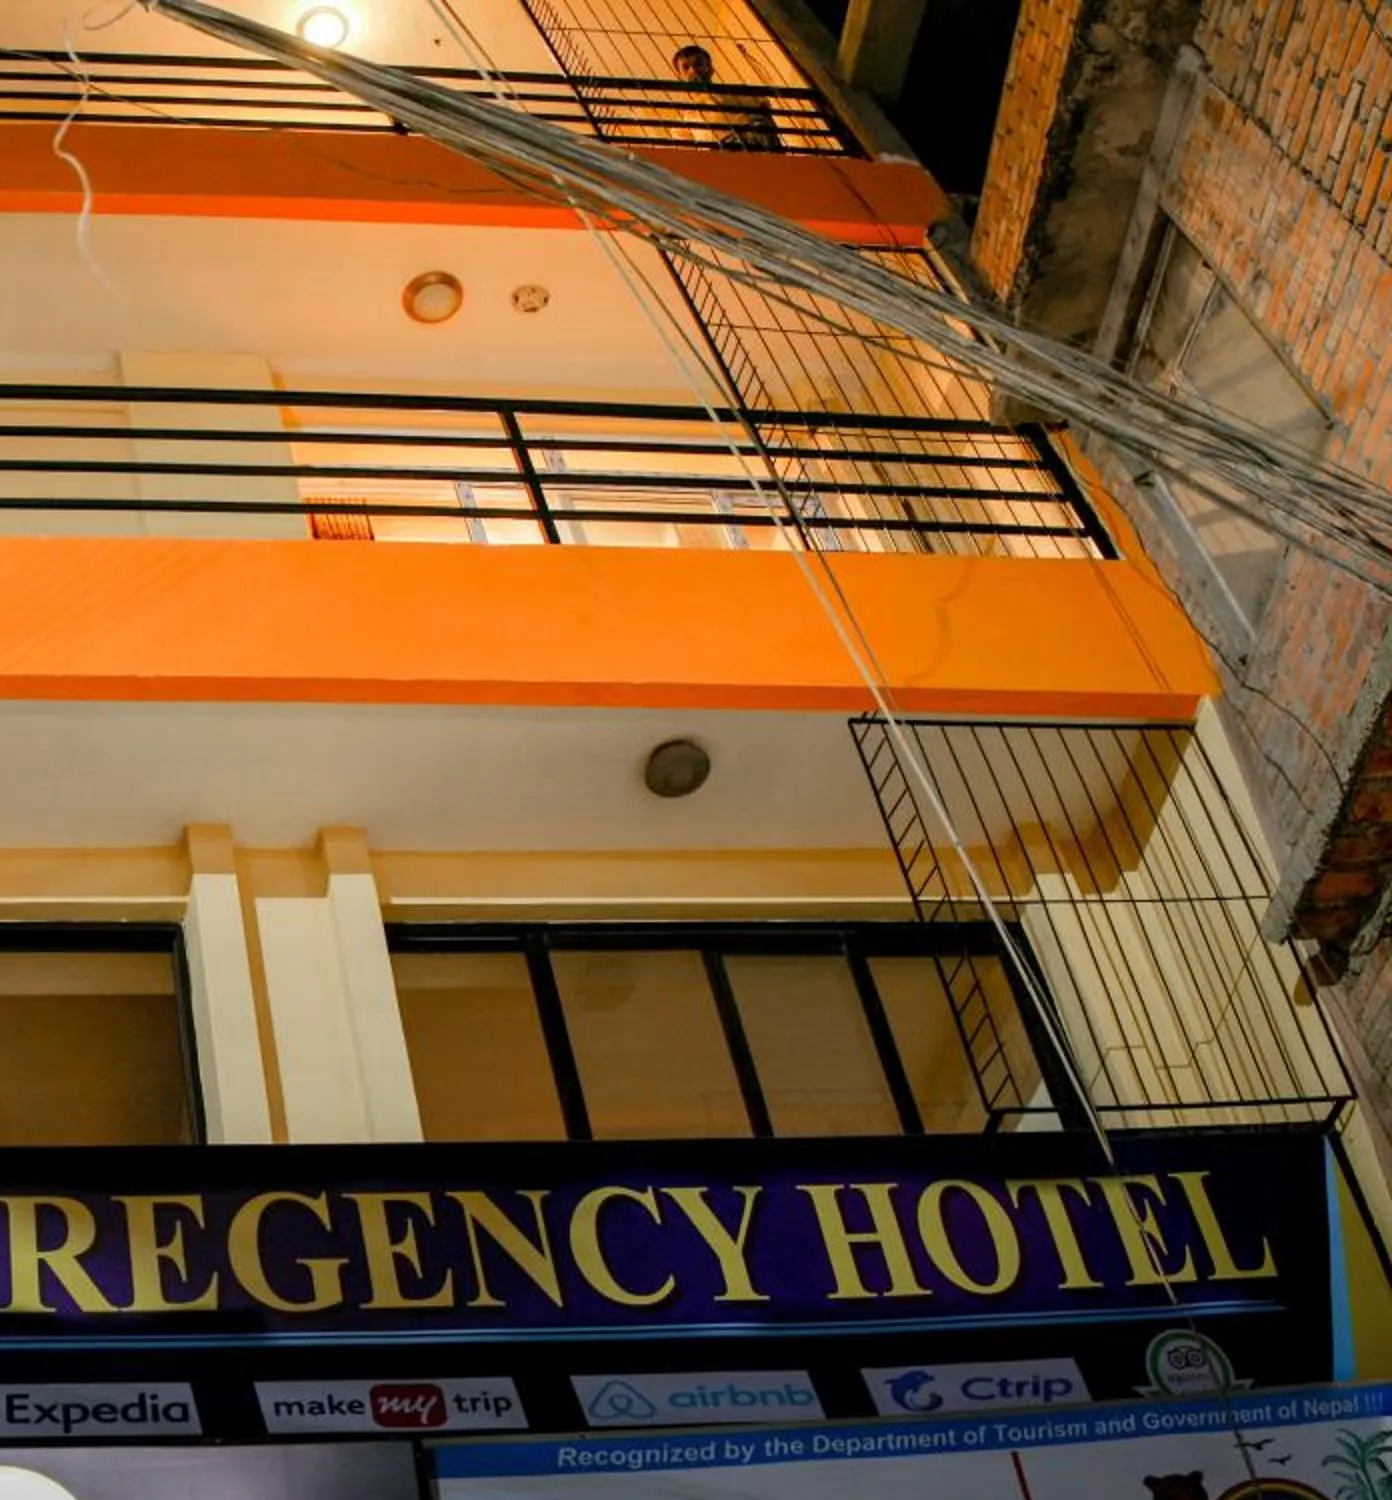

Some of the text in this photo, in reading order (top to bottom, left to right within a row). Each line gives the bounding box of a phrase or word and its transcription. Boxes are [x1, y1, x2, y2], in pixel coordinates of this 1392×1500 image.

[796, 1171, 1279, 1302] HOTEL
[273, 1388, 511, 1425] make my trip
[669, 1377, 815, 1410] airbnb
[961, 1373, 1073, 1402] Ctrip
[7, 1393, 190, 1434] Expedia
[557, 1442, 716, 1468] Recognized
[724, 1440, 753, 1463] by
[764, 1436, 804, 1456] the
[812, 1422, 957, 1456] Department
[962, 1424, 988, 1445] of
[994, 1419, 1087, 1443] Tourism
[1094, 1415, 1136, 1435] and
[1142, 1405, 1271, 1430] Government
[1277, 1401, 1299, 1420] of
[1303, 1396, 1359, 1417] Nepal
